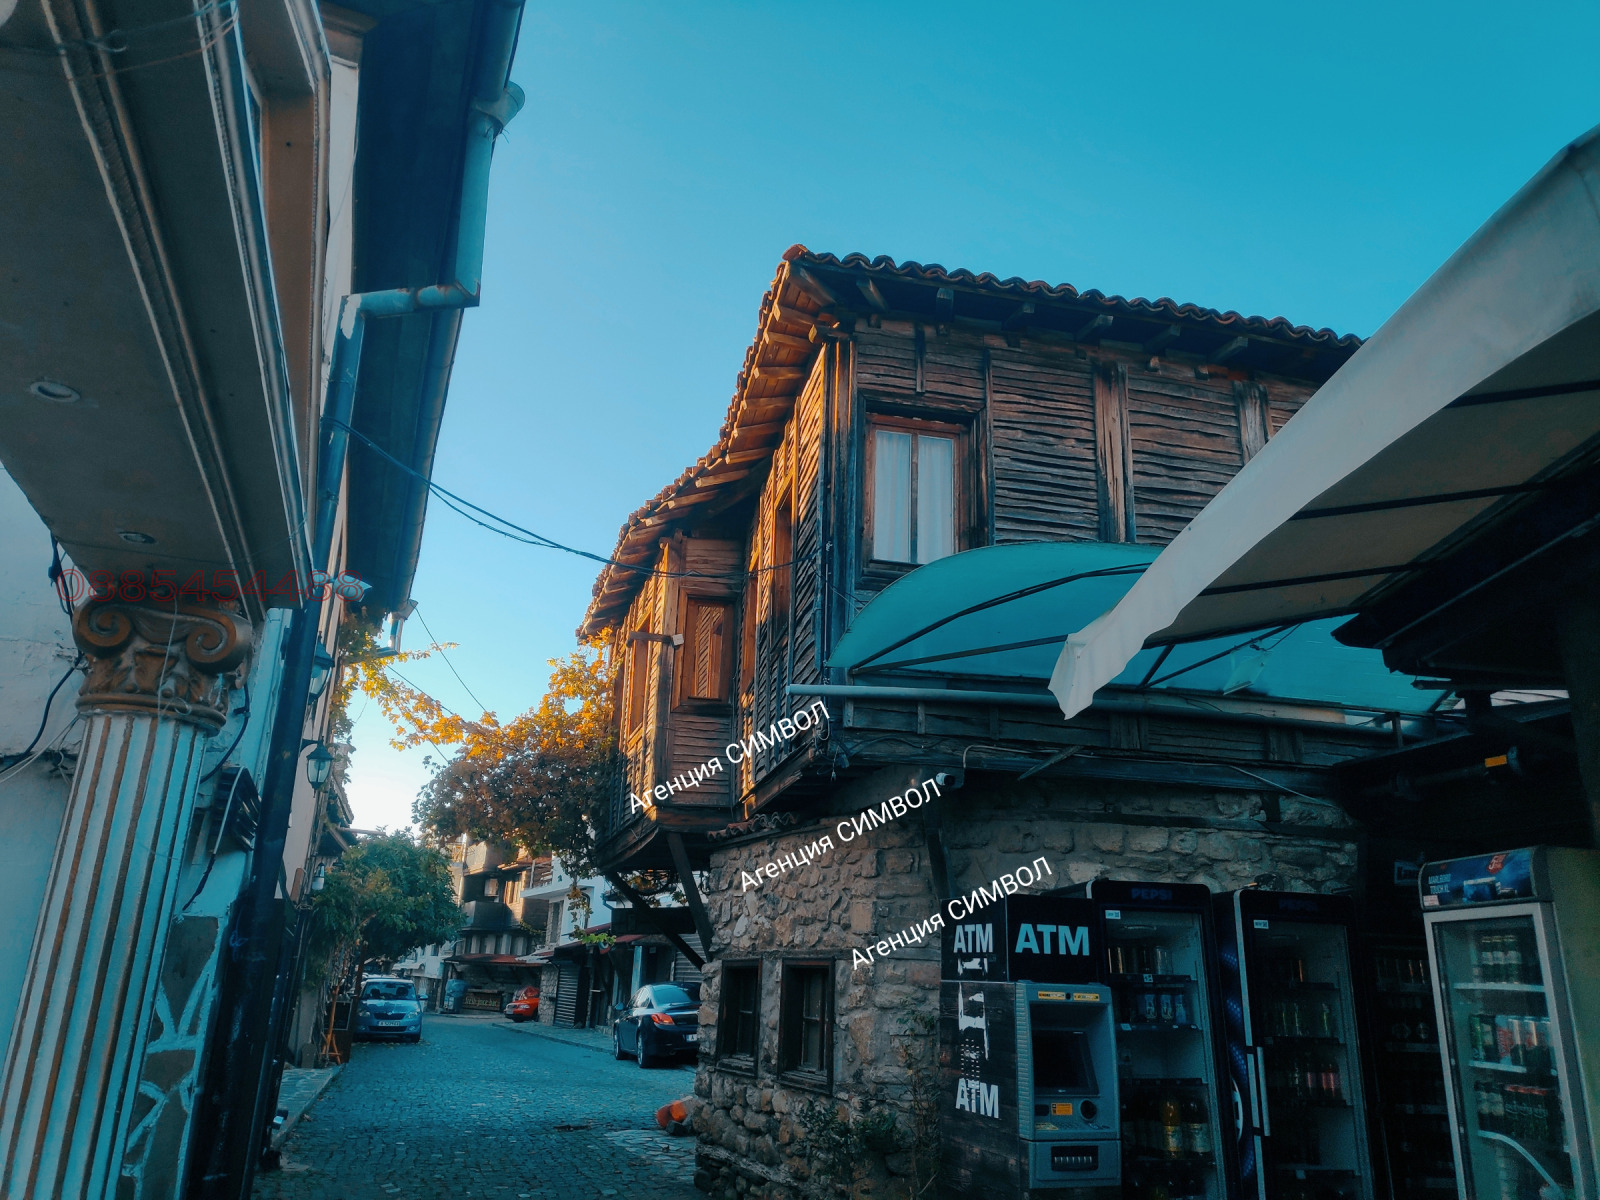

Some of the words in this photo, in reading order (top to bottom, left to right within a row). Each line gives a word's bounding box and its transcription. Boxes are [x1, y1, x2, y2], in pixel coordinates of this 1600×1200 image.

[1130, 888, 1173, 901] PEPSI
[953, 923, 993, 953] ATM
[1015, 923, 1090, 956] ATM
[955, 1077, 999, 1119] ATM
